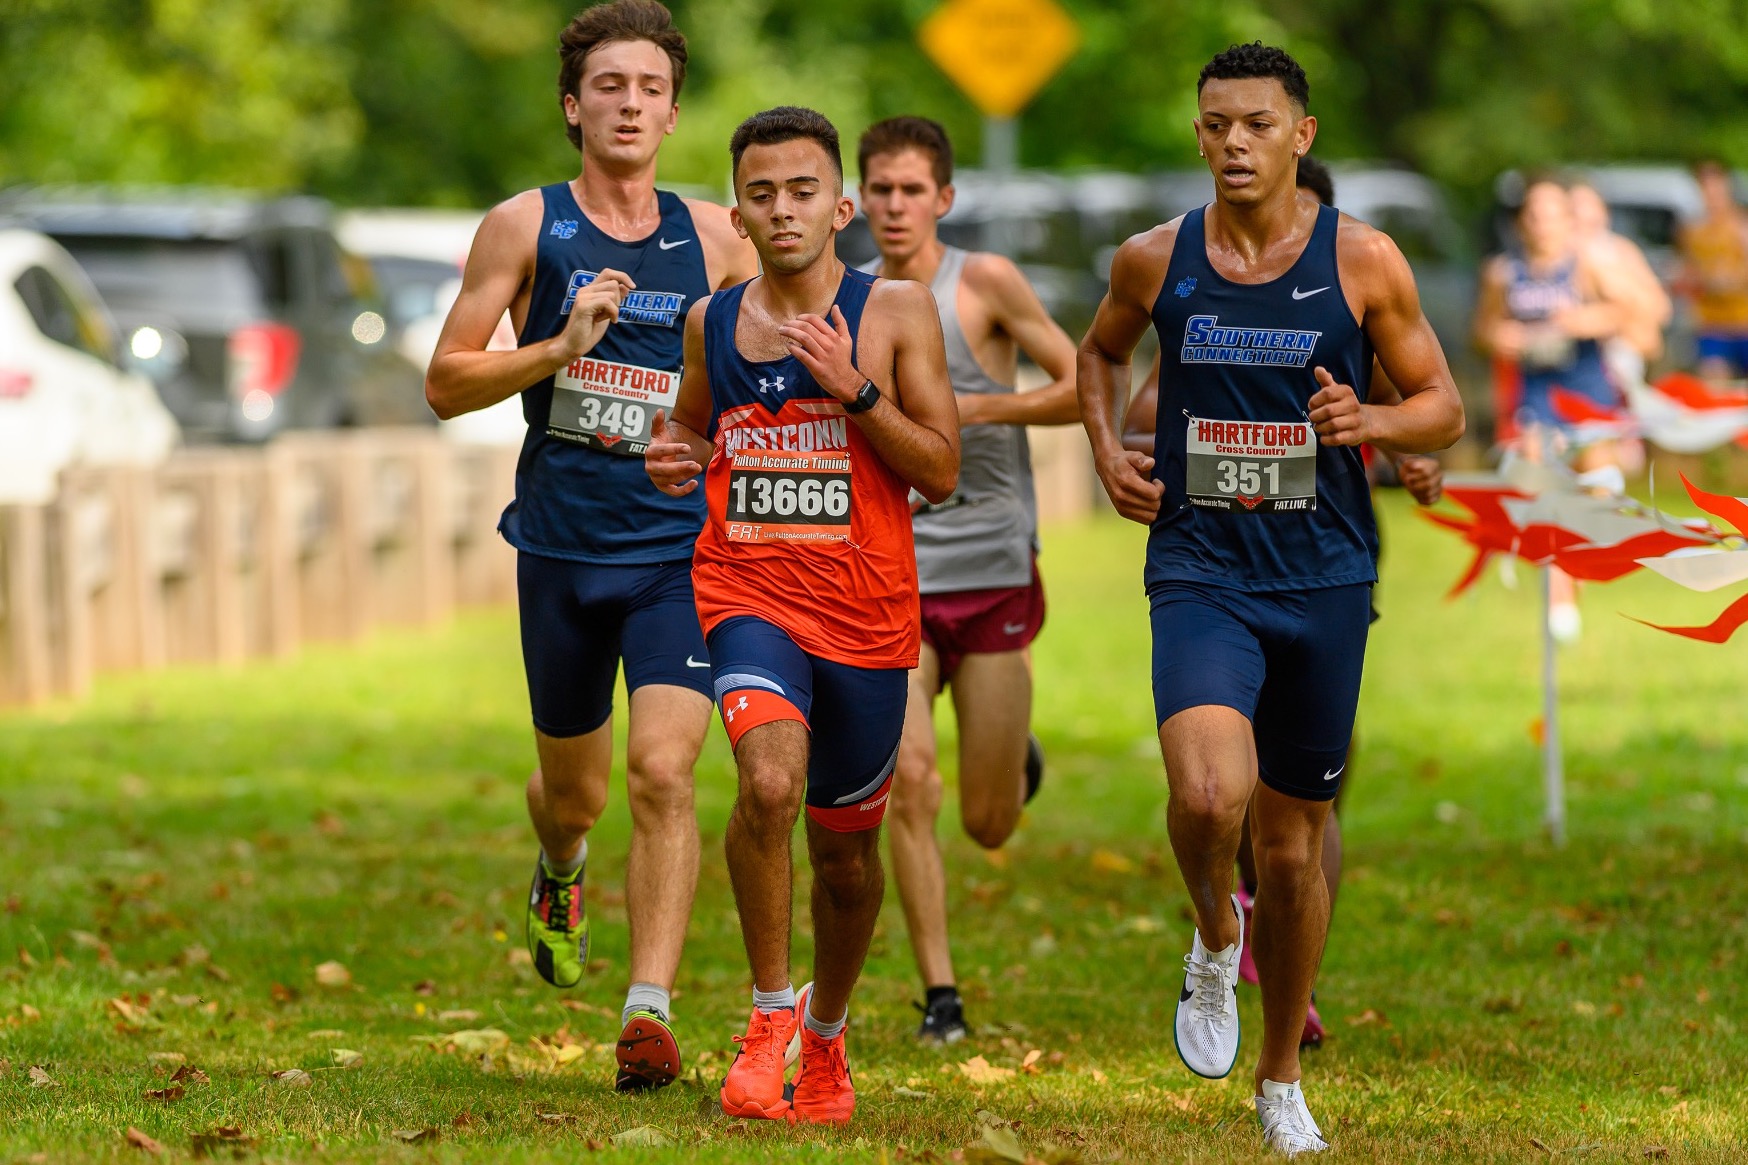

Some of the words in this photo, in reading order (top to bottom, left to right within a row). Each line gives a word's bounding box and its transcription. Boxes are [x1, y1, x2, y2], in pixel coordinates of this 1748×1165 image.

[569, 272, 680, 311] SHERN
[1185, 316, 1317, 351] SOUTHERN
[1183, 346, 1310, 366] CONNECTICUT
[567, 358, 671, 394] HARTFORD
[583, 382, 610, 393] Cross
[612, 387, 650, 400] Country
[578, 397, 646, 437] 349
[725, 416, 848, 458] WESTCONN
[1198, 420, 1307, 446] HARTFORD
[733, 454, 760, 468] Fulton
[762, 455, 809, 469] Accurate
[812, 457, 850, 471] Timing
[1216, 444, 1244, 455] Cross
[1246, 446, 1286, 456] Country
[1217, 460, 1279, 495] 351
[732, 476, 849, 517] 13666
[1274, 499, 1307, 510] FAT.LIVE
[728, 523, 762, 540] FAT
